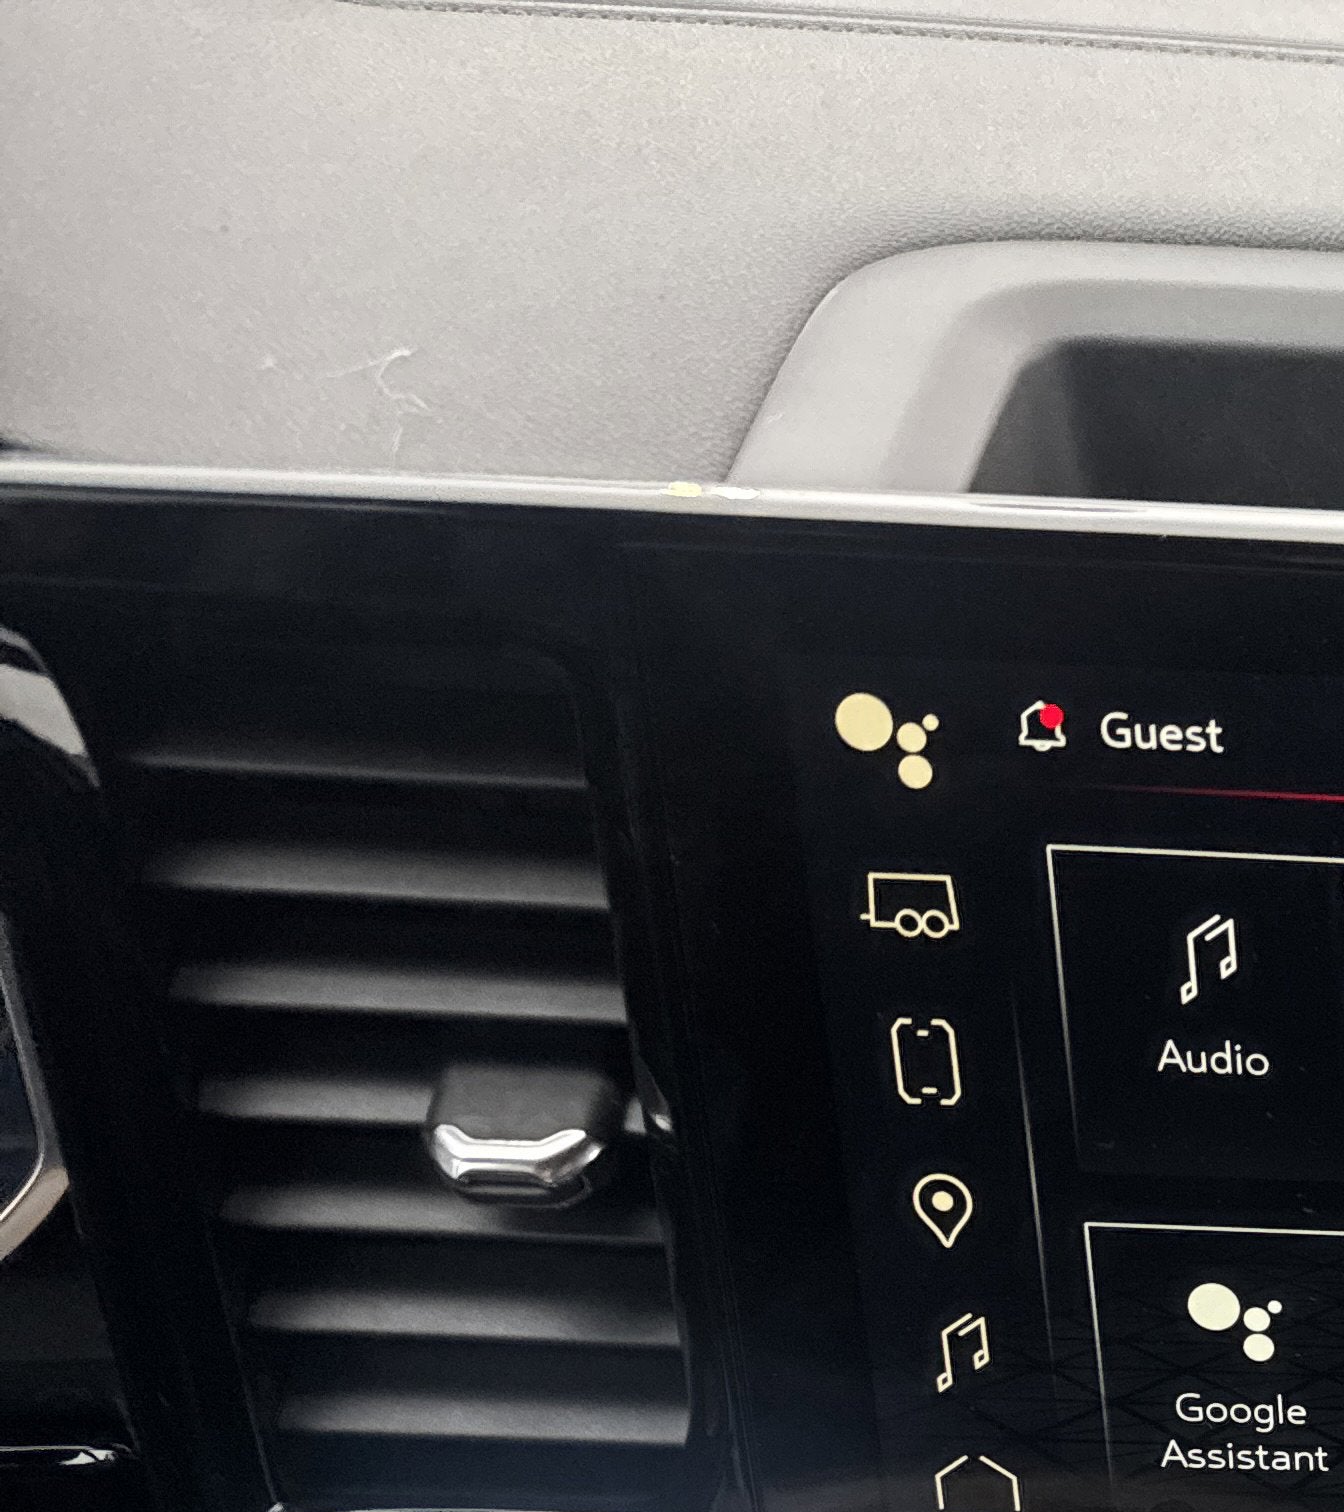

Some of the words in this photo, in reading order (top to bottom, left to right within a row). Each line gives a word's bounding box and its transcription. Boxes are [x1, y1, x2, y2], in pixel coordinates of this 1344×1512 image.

[1100, 711, 1225, 754] Guest
[1157, 1039, 1269, 1077] Audio
[1175, 1393, 1307, 1433] Google
[1160, 1440, 1329, 1473] Assistant
